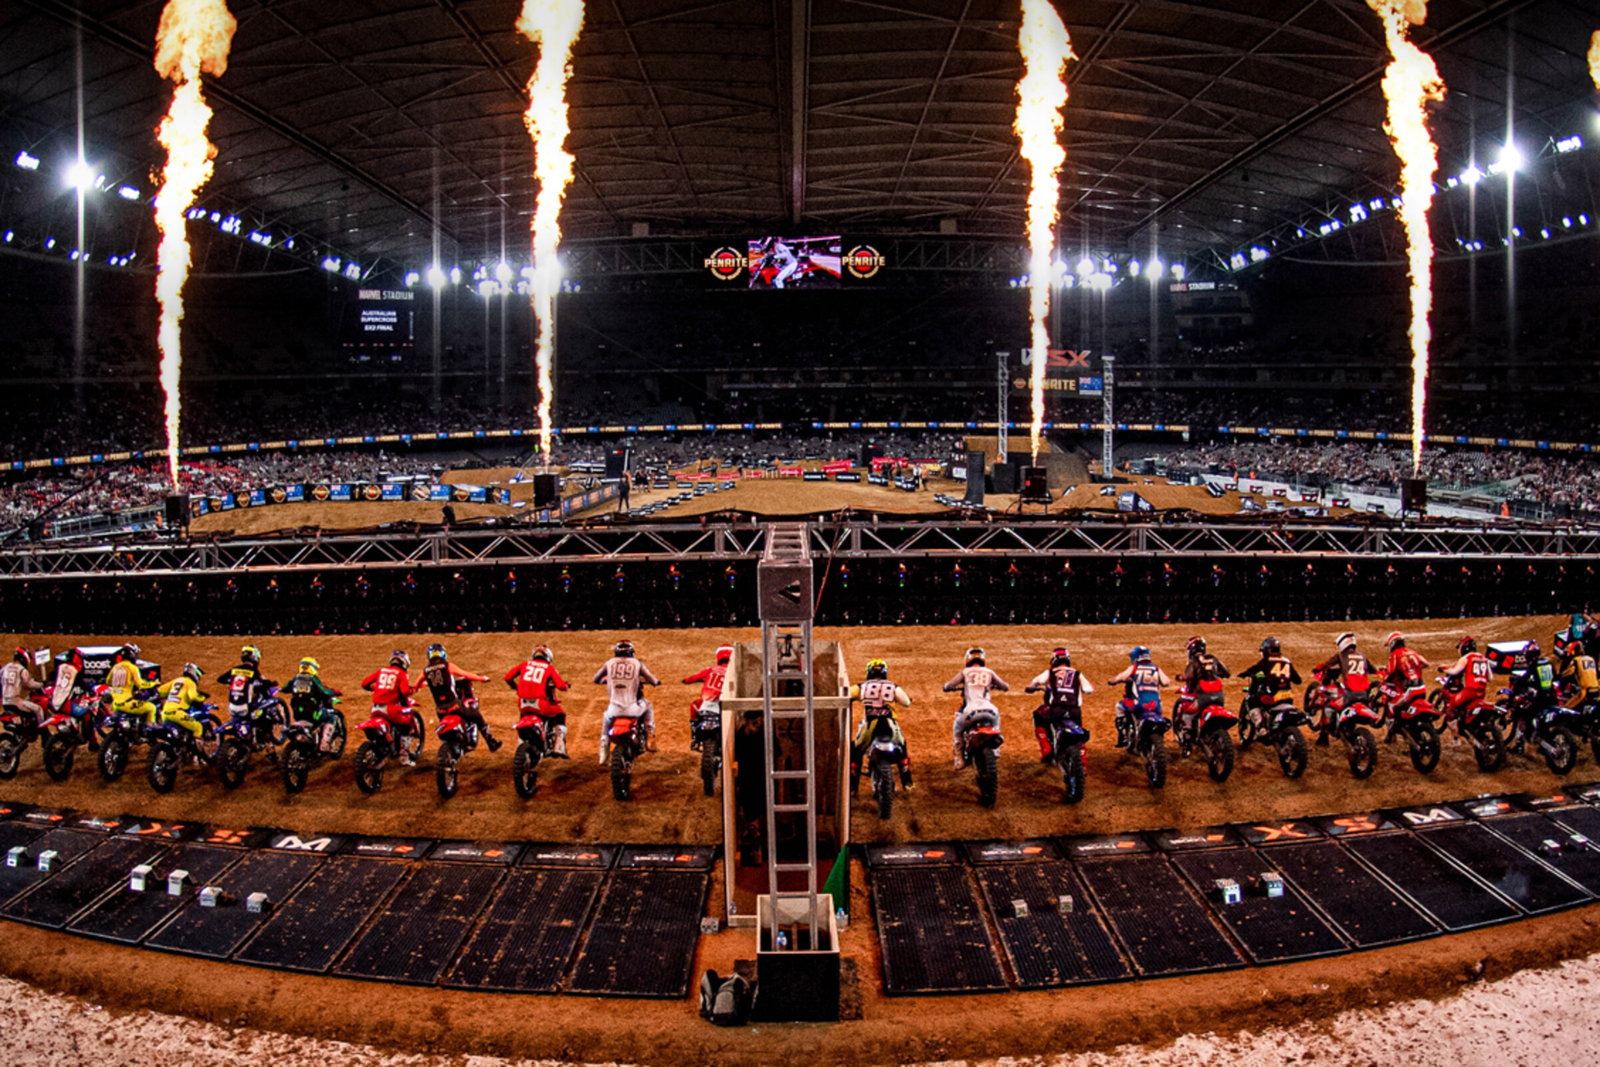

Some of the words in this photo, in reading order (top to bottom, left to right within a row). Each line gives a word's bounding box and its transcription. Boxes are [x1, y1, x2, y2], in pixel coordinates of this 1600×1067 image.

[704, 257, 748, 269] PENRITE
[842, 256, 886, 267] PENRITE
[382, 291, 414, 300] STADIUM
[83, 659, 111, 669] boost
[610, 662, 636, 680] 199
[1270, 662, 1291, 678] 44
[1347, 660, 1366, 675] 24
[1472, 661, 1488, 677] 49
[378, 672, 398, 690] 99
[523, 665, 546, 684] 20
[967, 671, 991, 687] 38
[864, 681, 896, 702] 88
